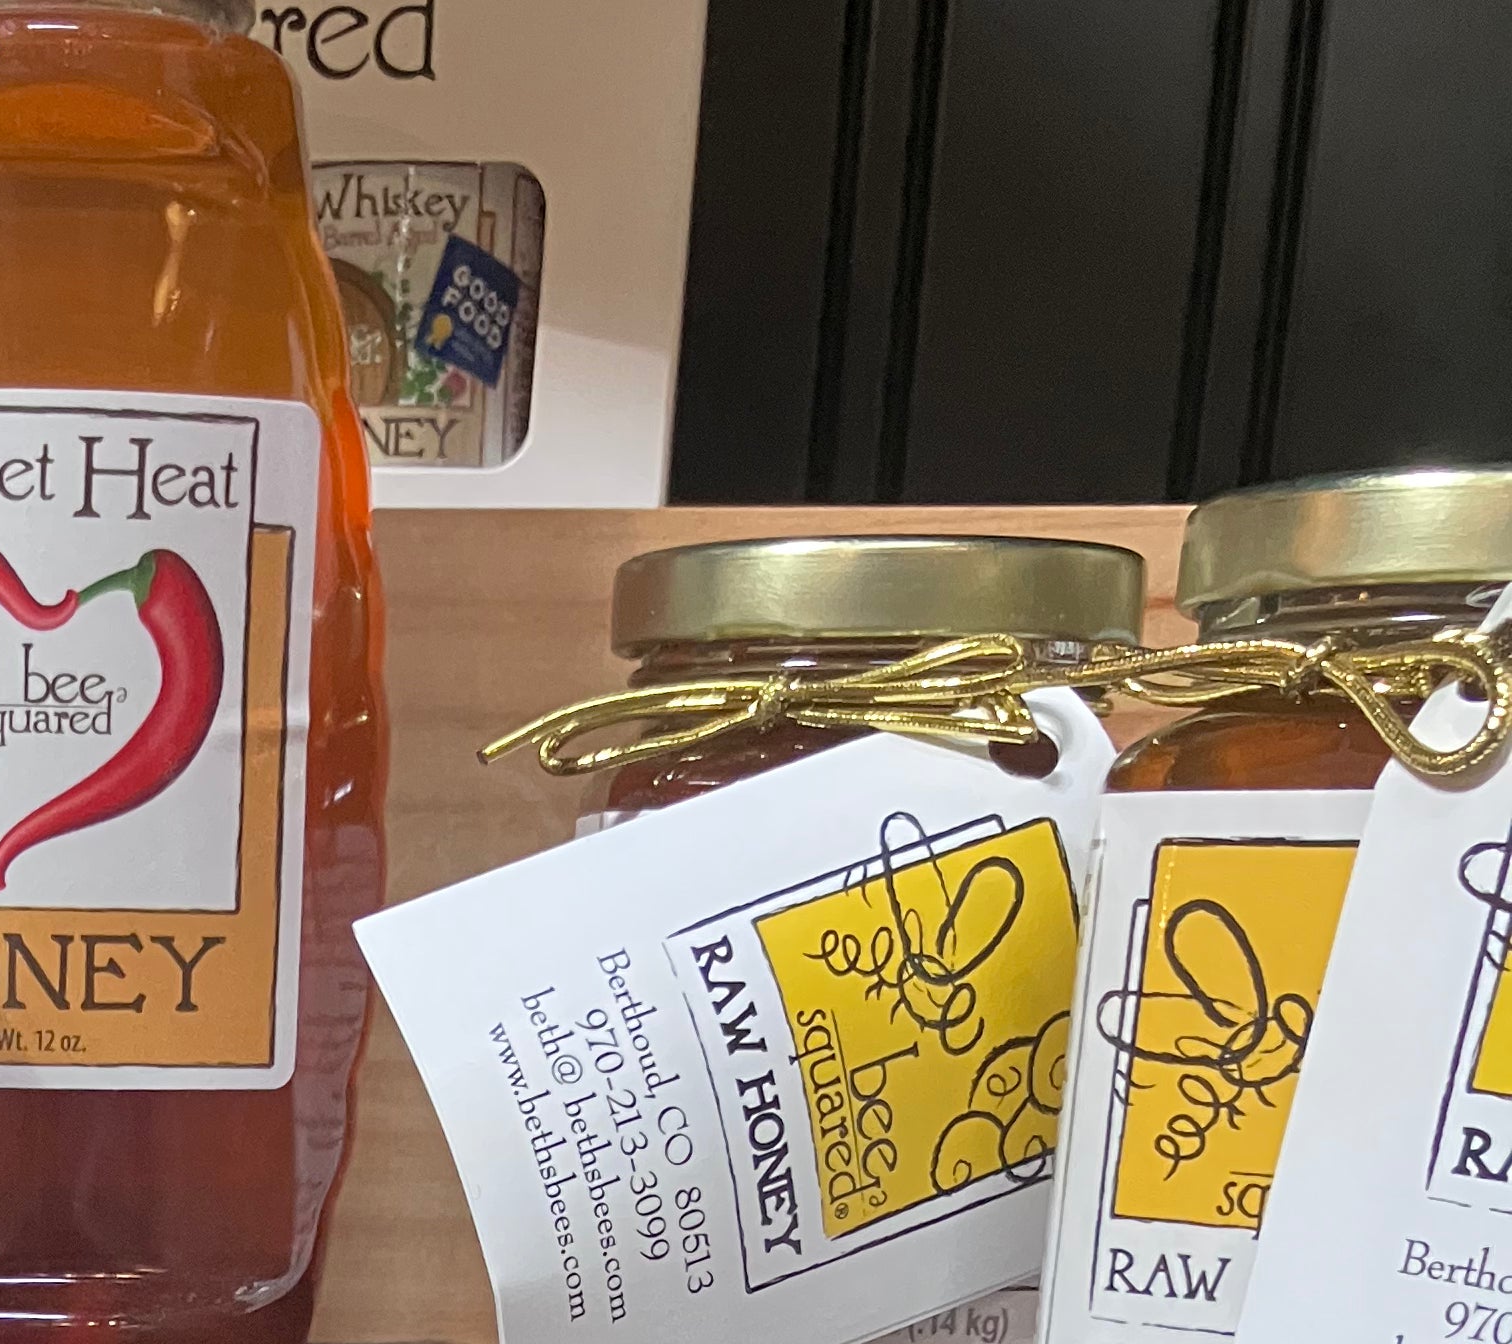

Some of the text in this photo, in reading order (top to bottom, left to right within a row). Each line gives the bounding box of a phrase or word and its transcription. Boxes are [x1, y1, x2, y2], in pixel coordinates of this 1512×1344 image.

[73, 434, 239, 520] Heat
[364, 417, 465, 459] NEY
[22, 642, 110, 705] bee
[36, 1028, 55, 1053] 12
[60, 1034, 86, 1054] oz.
[575, 1009, 670, 1262] 970-213-3099
[597, 947, 714, 1295] Berthoud, CO 80513
[691, 934, 802, 1255] RAW HONEY
[850, 1041, 920, 1178] bee
[488, 1022, 586, 1322] www.bethsbees.com
[563, 1092, 627, 1324] bethsbees.com
[1104, 1247, 1232, 1302] RAW
[1397, 1237, 1512, 1295] Bertho
[966, 1307, 1009, 1344] kg)
